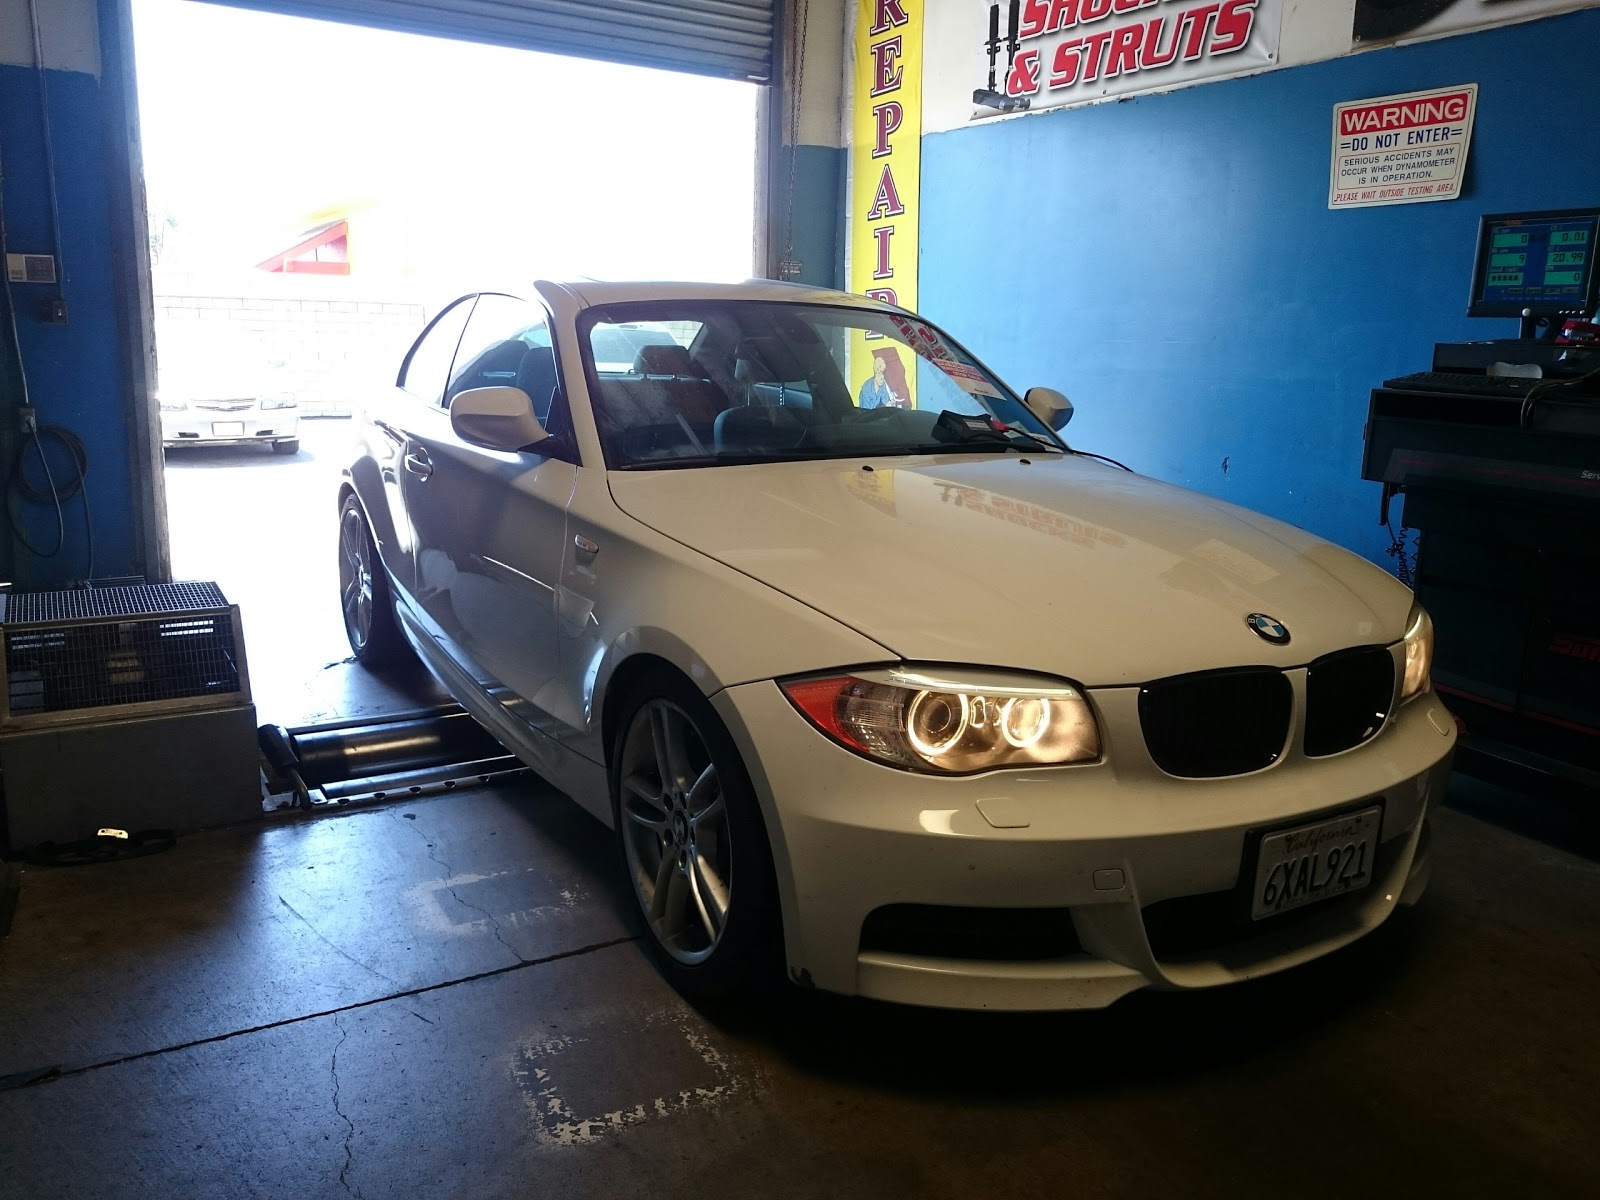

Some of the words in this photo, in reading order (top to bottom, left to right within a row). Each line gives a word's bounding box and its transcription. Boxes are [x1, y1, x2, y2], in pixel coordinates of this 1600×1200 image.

[1006, 48, 1041, 98] &
[1048, 0, 1260, 91] STRUTS
[1344, 98, 1464, 132] WARNING
[1375, 133, 1400, 149] NOT
[1344, 156, 1380, 167] SERIOUS
[1384, 149, 1432, 162] ACCIDENTS
[1436, 147, 1455, 156] MAY
[1341, 168, 1367, 176] OCCUR
[1371, 164, 1393, 174] WHEN
[1396, 158, 1455, 171] DYNAMOMETER
[1370, 175, 1379, 183] IN
[1382, 171, 1433, 182] OPERATION.
[1336, 192, 1358, 202] PLEASE
[1361, 190, 1376, 199] WAIT
[1379, 188, 1405, 198] OUTSIDE
[1407, 185, 1434, 195] TESTING
[1521, 235, 1528, 244] 0
[1562, 232, 1585, 242] 0.01
[1573, 273, 1580, 281] 0
[1286, 825, 1359, 853] California
[1263, 840, 1366, 909] 6XAL921
